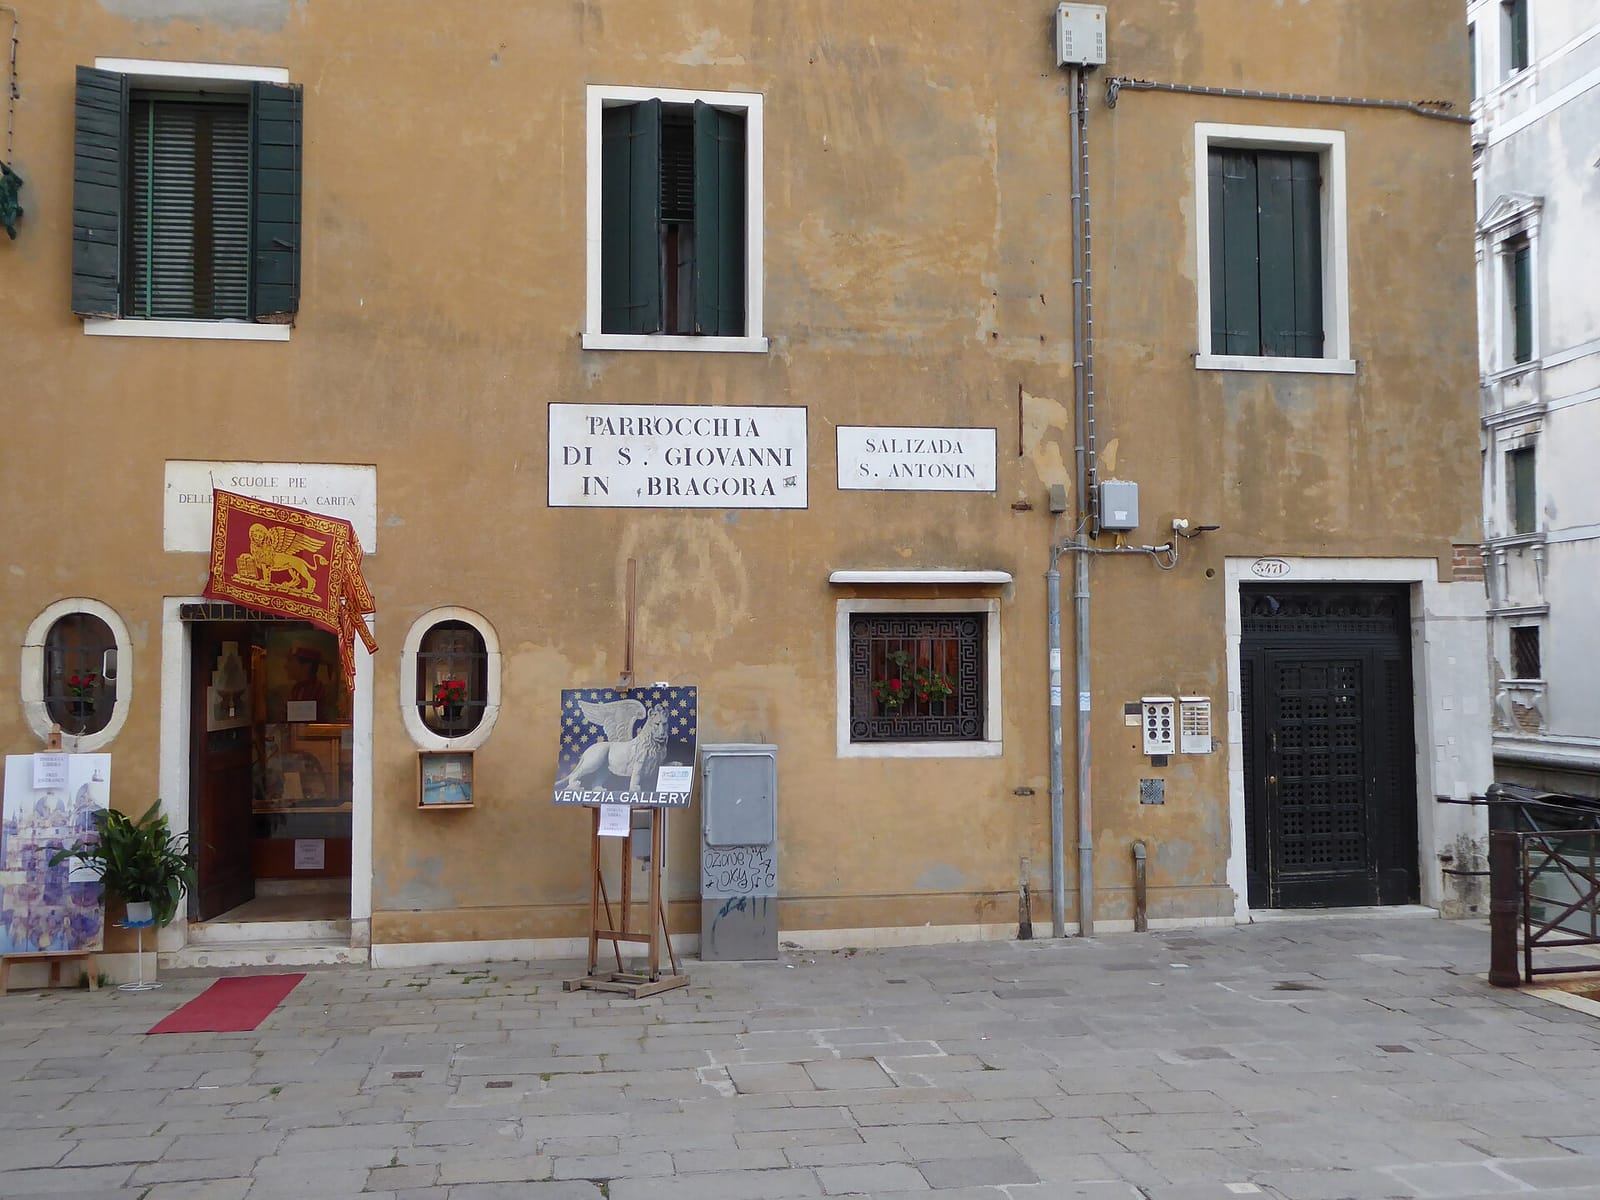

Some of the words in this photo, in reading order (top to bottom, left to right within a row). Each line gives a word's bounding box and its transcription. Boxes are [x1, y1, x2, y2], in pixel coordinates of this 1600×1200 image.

[586, 415, 760, 438] PARROCCHIA
[865, 438, 963, 454] SALIZADA
[563, 446, 592, 466] DI
[664, 447, 793, 467] GIOVANNI
[859, 463, 879, 477] S.
[888, 463, 976, 479] ANTONIN
[231, 476, 279, 489] SCUOLE
[288, 477, 307, 489] PIE
[582, 476, 610, 496] IN
[647, 476, 776, 496] BRAGORA
[272, 495, 308, 506] DELLA
[553, 790, 615, 802] VENEZIA
[619, 791, 690, 804] GALLERY
